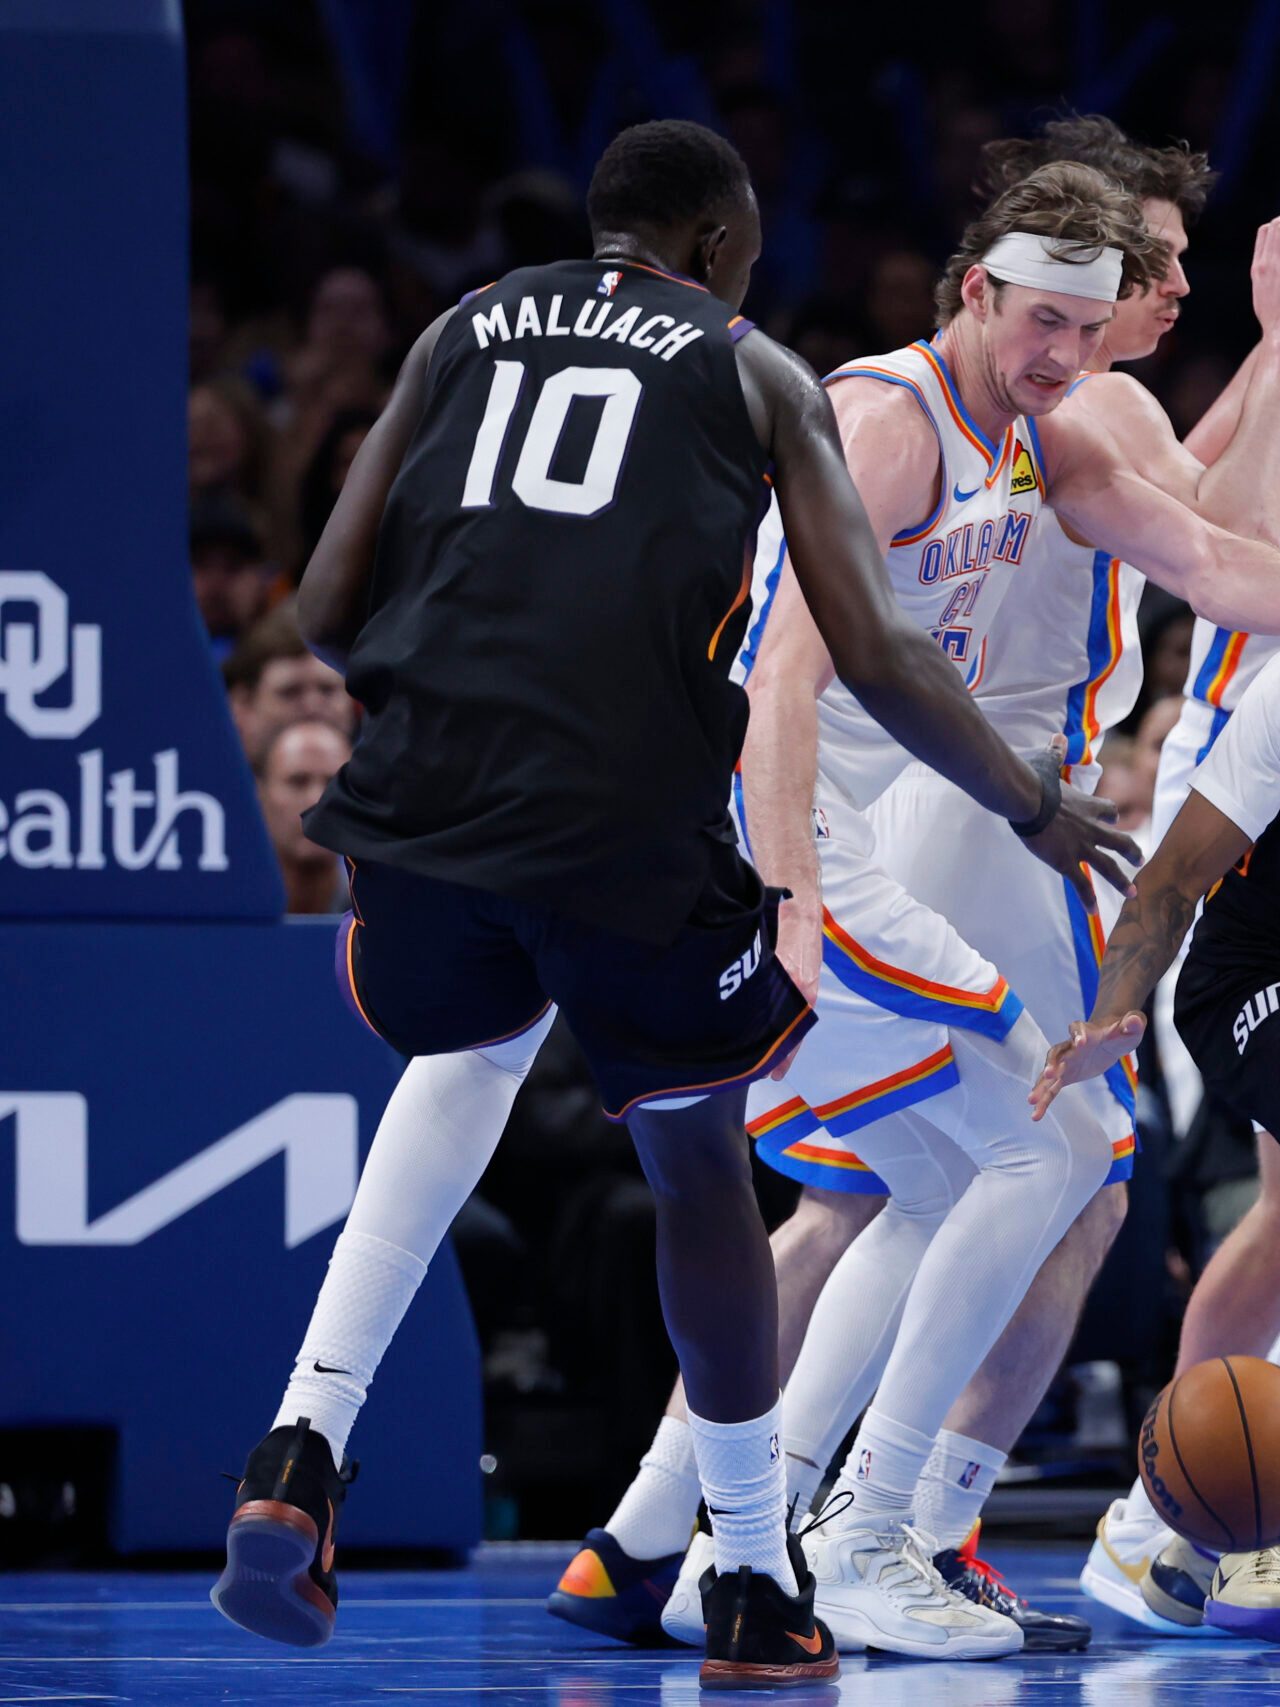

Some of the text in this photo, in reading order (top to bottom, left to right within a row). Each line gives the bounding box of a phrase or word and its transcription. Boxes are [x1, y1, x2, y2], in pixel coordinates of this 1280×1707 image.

[471, 293, 705, 362] MALUACH
[461, 359, 643, 516] 10
[0, 748, 229, 871] alth
[718, 928, 762, 1001] SU
